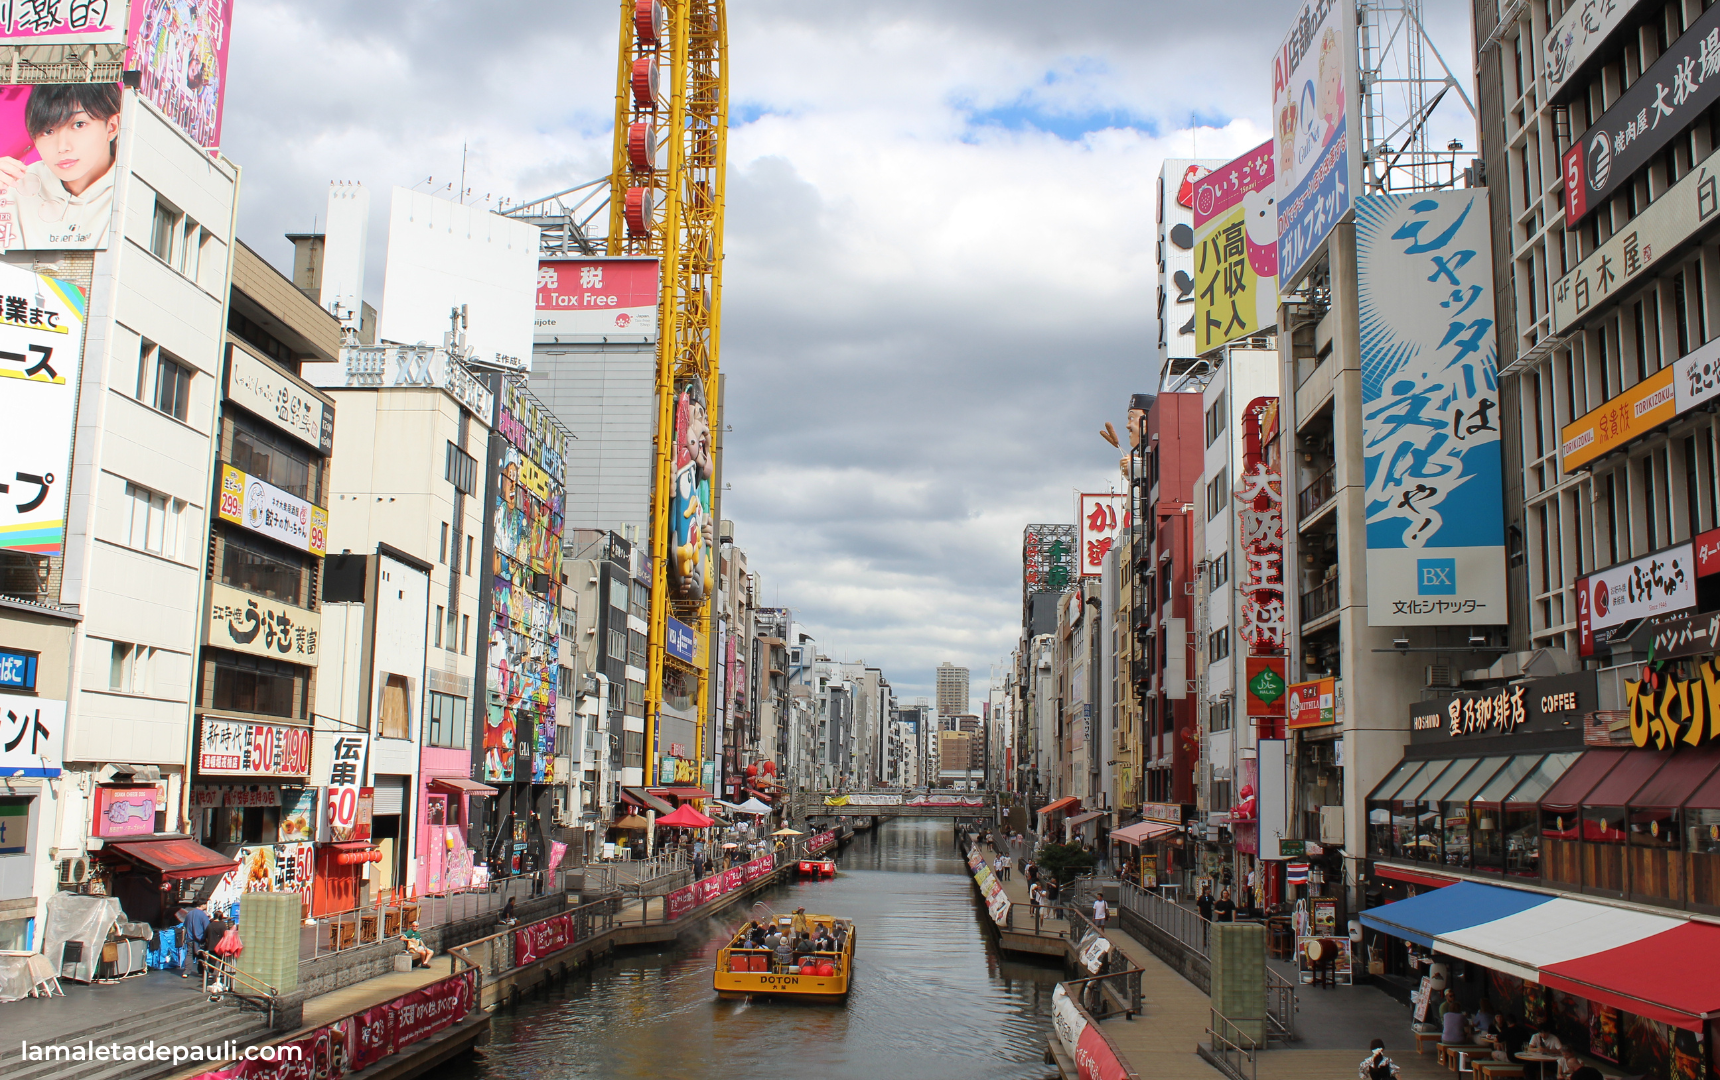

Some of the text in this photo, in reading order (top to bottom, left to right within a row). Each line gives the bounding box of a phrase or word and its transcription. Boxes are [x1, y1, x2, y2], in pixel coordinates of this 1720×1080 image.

[1614, 107, 1649, 156] 焼肉屋
[1651, 27, 1720, 130] 大牧場
[1214, 151, 1274, 198] いちごな
[1281, 170, 1346, 279] ガルフネット
[1575, 231, 1642, 315] 白木屋
[0, 296, 59, 329] 業まで
[551, 293, 578, 306] Tax
[584, 293, 618, 306] Free
[1635, 387, 1671, 416] TORIKIZOKU
[1563, 431, 1591, 455] TORIKIZOKU
[221, 492, 238, 516] 299
[311, 526, 323, 550] 99
[1422, 567, 1452, 586] BX
[228, 599, 294, 654] うなぎ
[0, 656, 23, 683] ばこ
[1448, 685, 1526, 737] 星乃珈琲店
[1541, 692, 1576, 713] COFFEE
[0, 707, 50, 755] ント
[207, 721, 243, 753] 新時代
[1413, 713, 1441, 730] HOSHINO
[252, 726, 274, 772] 50
[282, 729, 310, 773] 190
[331, 736, 363, 786] 伝串
[760, 976, 799, 985] DOTON
